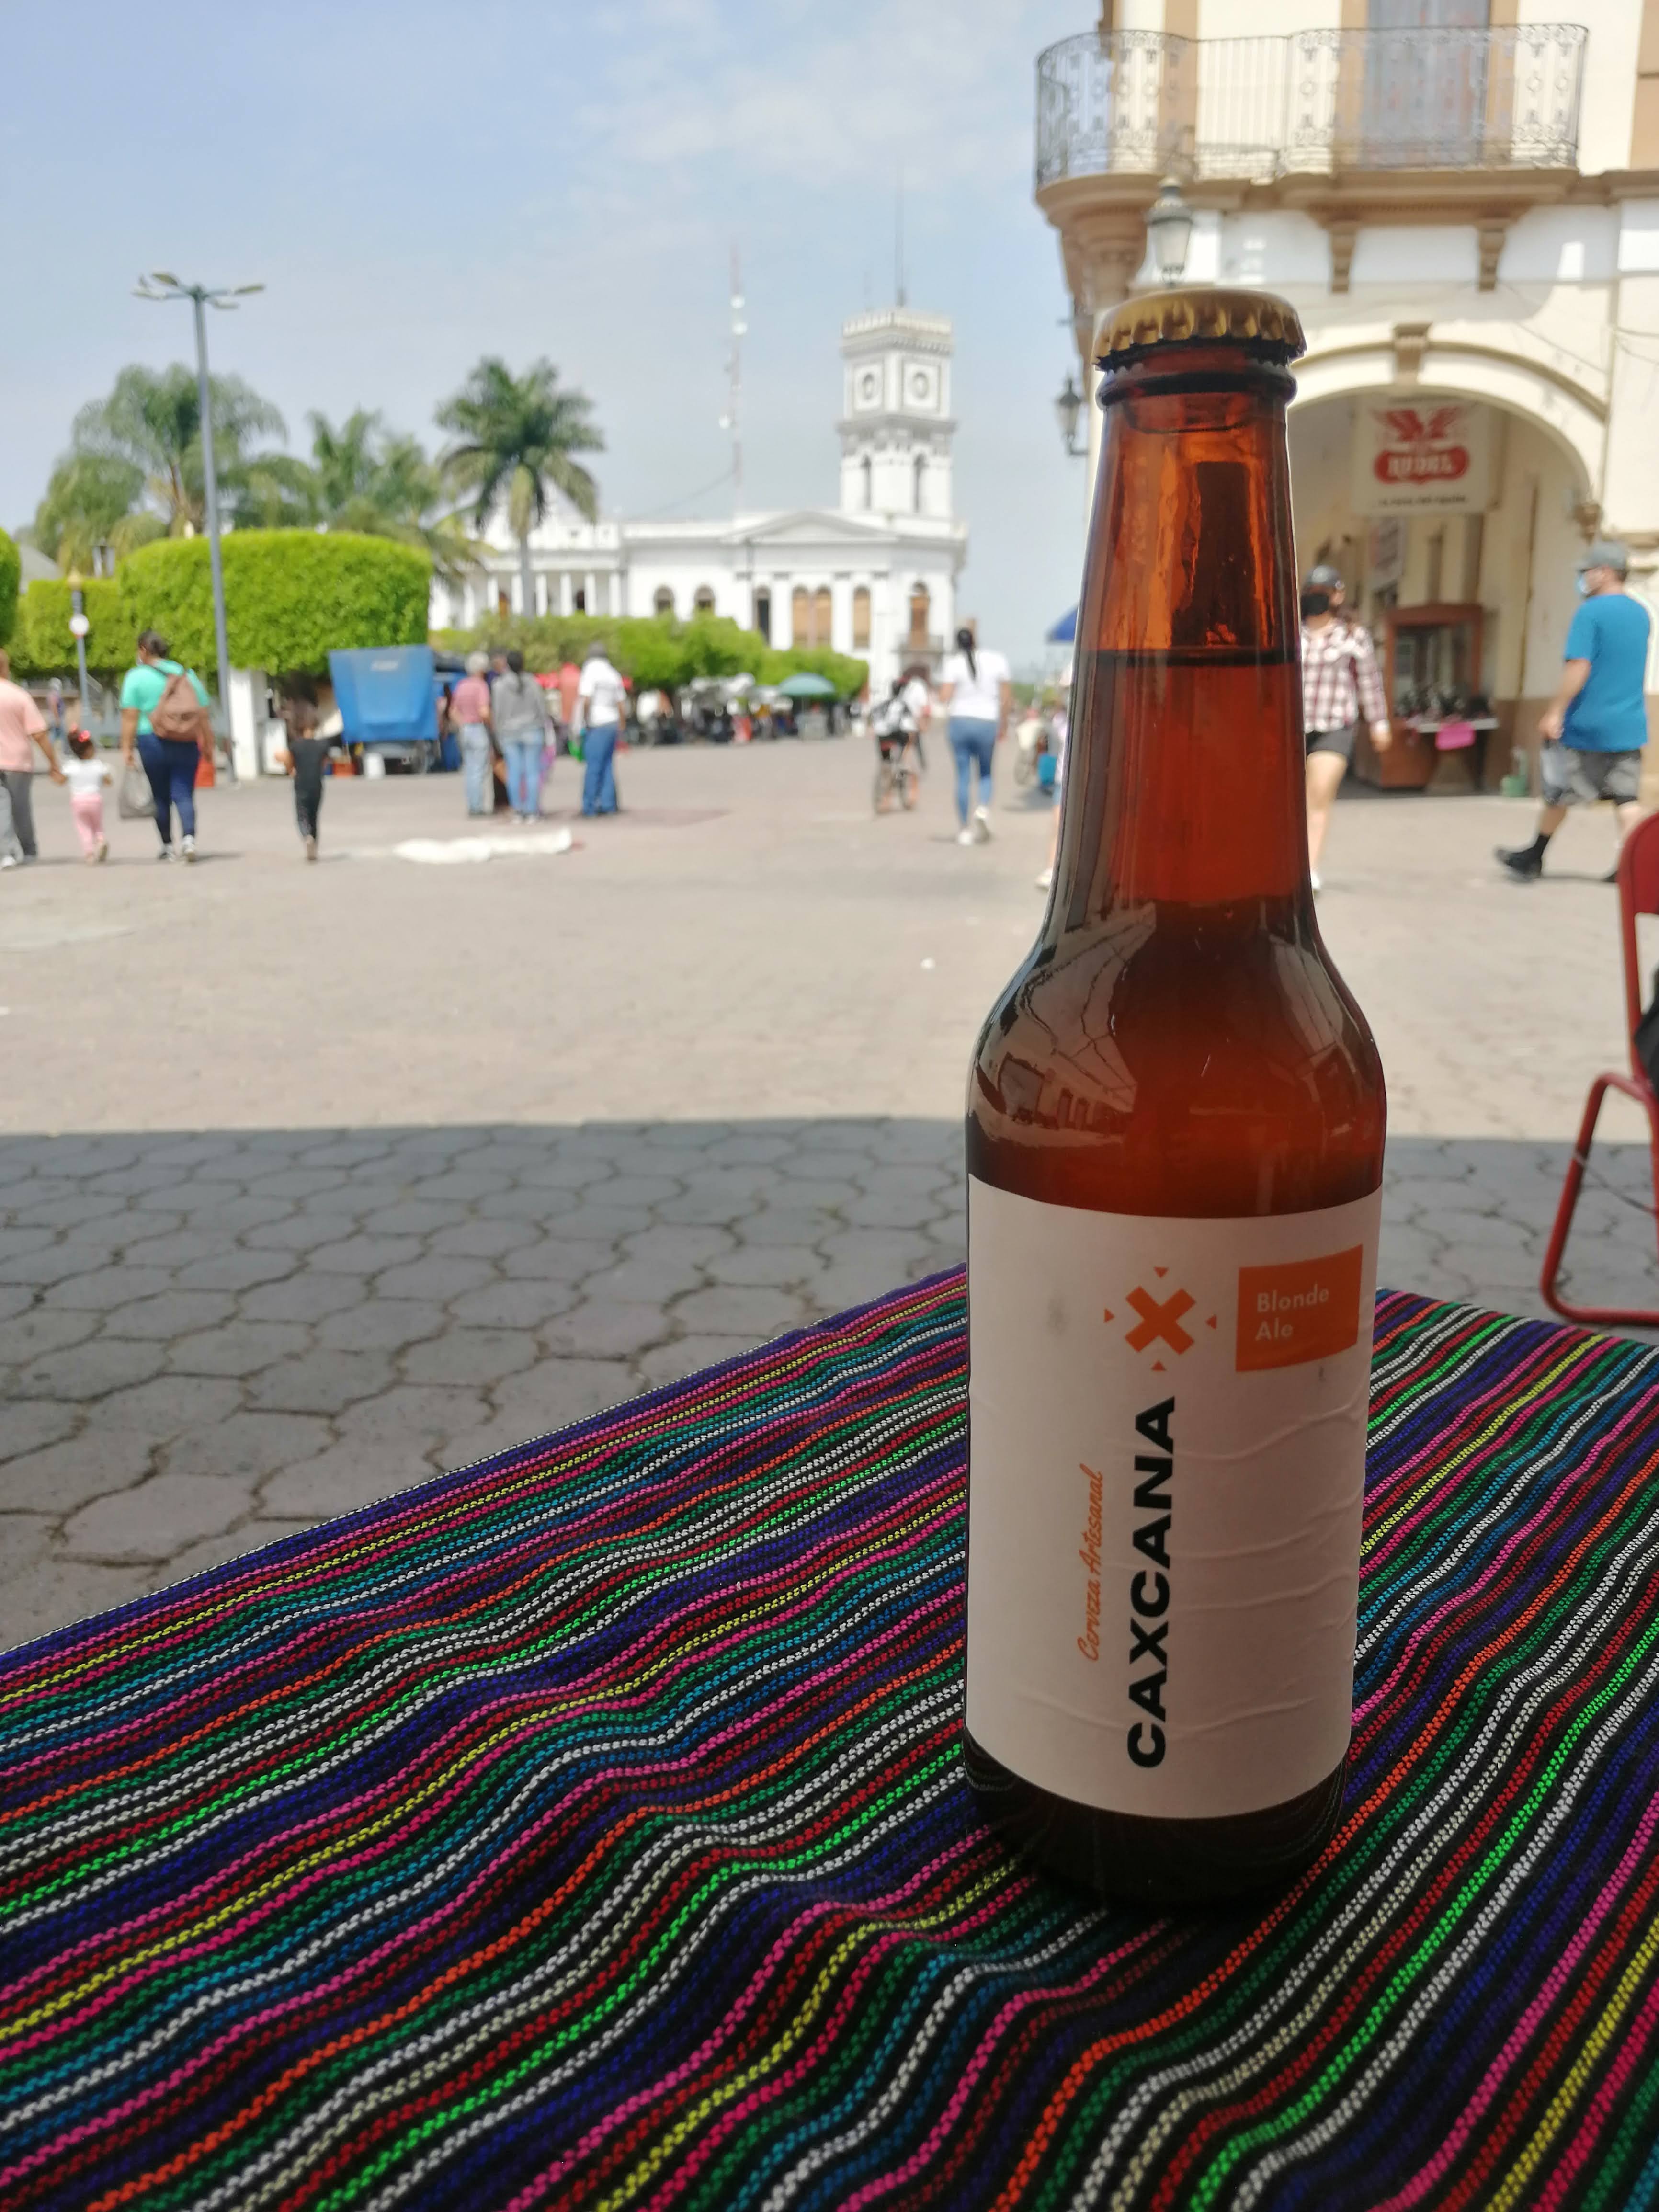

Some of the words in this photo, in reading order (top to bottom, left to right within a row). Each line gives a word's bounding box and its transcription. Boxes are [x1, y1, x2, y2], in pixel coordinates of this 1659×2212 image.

[1255, 1317, 1294, 1342] Ale
[1256, 1280, 1330, 1313] Blonde
[1079, 1463, 1103, 1576] Artesanal
[1077, 1579, 1100, 1661] Cerveza
[1127, 1395, 1175, 1768] CAXCANA
